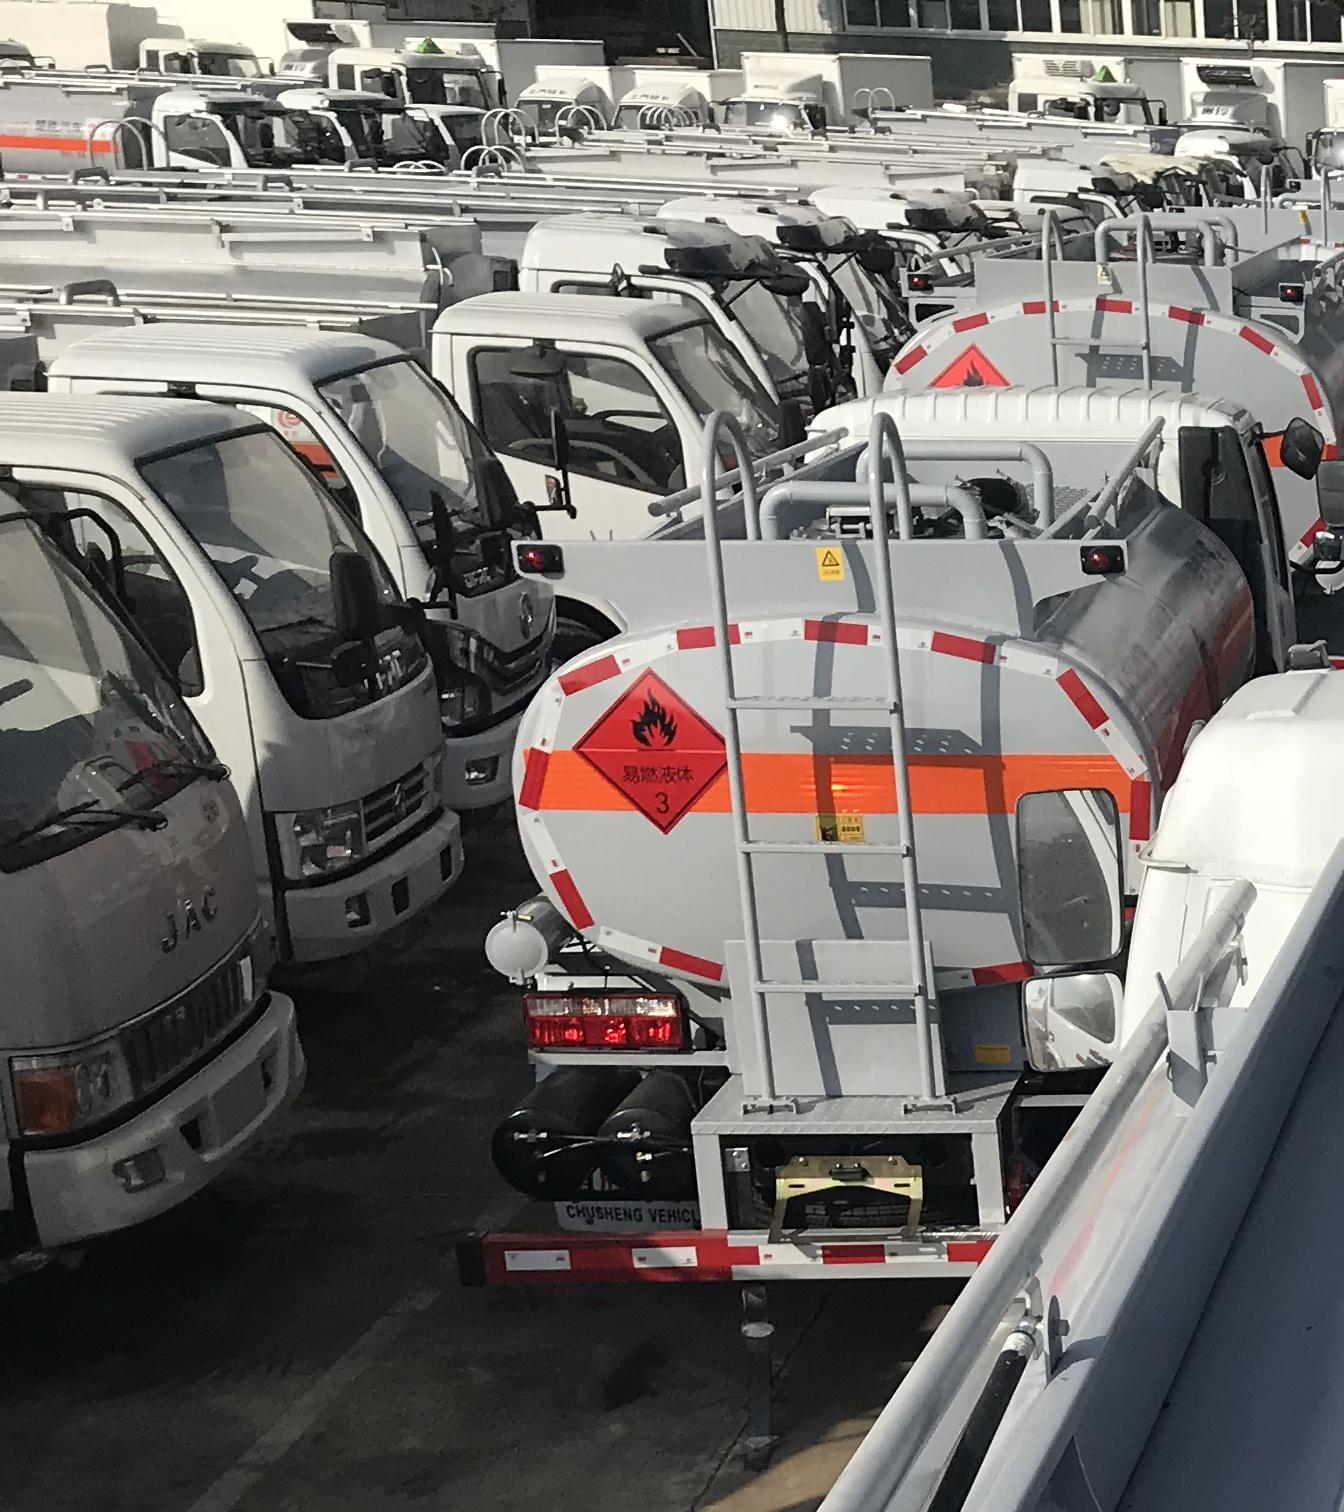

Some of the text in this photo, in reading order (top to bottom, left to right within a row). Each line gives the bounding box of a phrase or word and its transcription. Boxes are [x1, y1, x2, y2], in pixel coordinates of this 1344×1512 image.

[622, 765, 695, 785] 易燃液体
[654, 791, 671, 815] 3
[160, 881, 219, 954] JAC
[565, 1204, 701, 1224] CHUSHENG VEHICL
